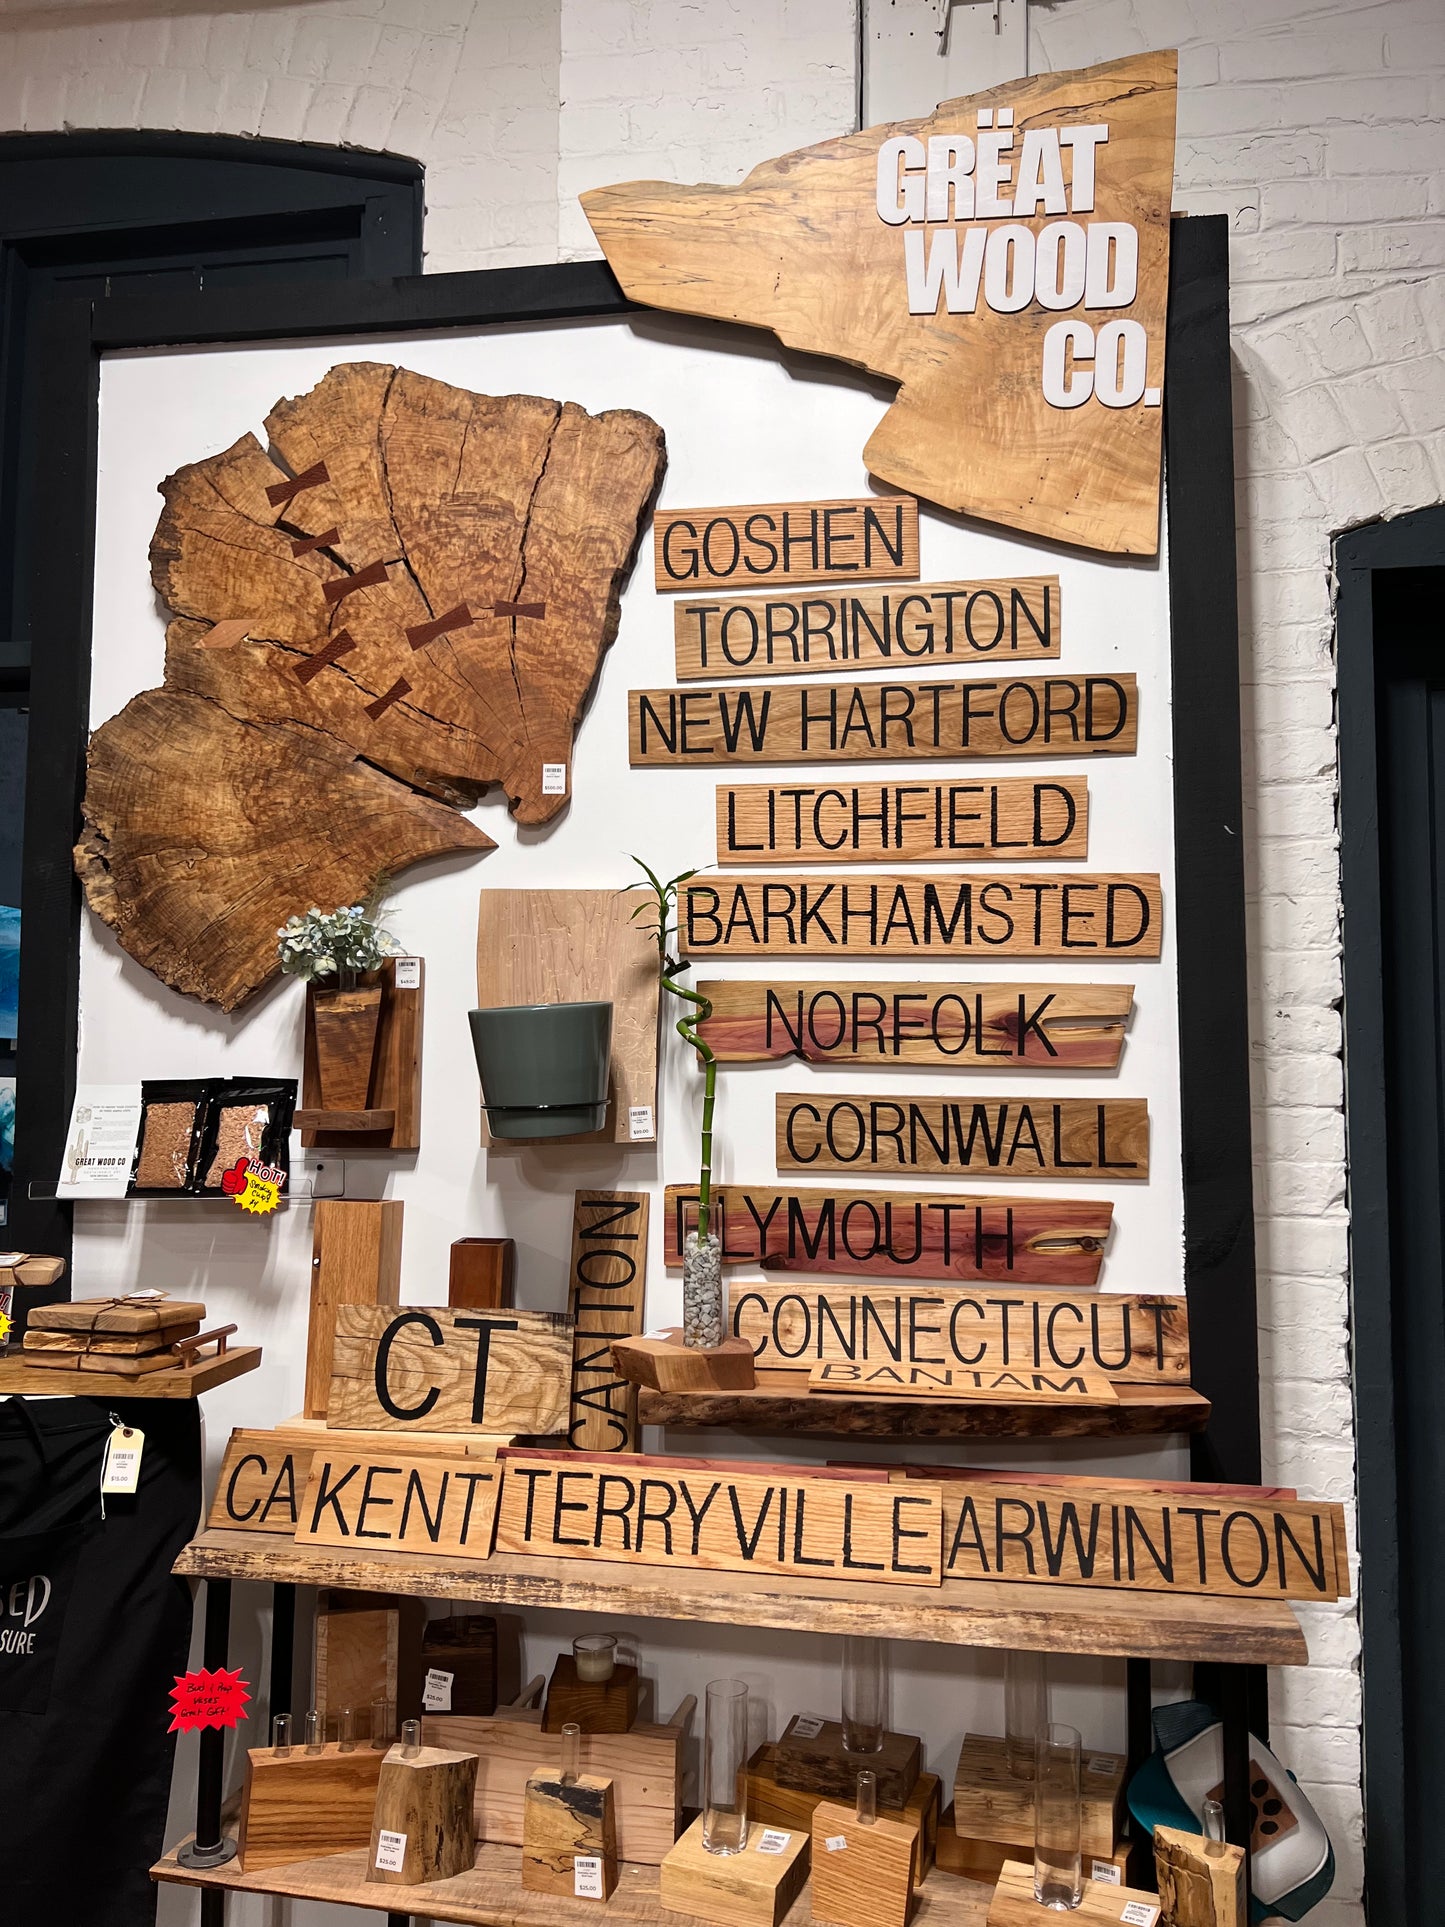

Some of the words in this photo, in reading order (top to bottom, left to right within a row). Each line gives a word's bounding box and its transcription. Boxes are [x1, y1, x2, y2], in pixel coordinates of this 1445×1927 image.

[876, 107, 1109, 226] GRËAT
[903, 220, 1139, 316] WOOD
[1042, 318, 1162, 409] CO.
[662, 505, 904, 580] GOSHEN
[685, 586, 1051, 668] TORRINGTON
[640, 690, 771, 754] NEW
[800, 677, 1128, 751] HARTFORD
[727, 783, 1076, 852] LITCHFIELD
[686, 883, 1150, 949] BARKHAMSTED
[765, 989, 1058, 1057] NORFOLK
[75, 1157, 96, 1166] GREAT
[97, 1157, 117, 1166] WOOD
[117, 1157, 126, 1166] CO
[249, 1159, 285, 1186] HOT!
[786, 1101, 1138, 1170] CORNWALL
[567, 1200, 641, 1453] CANTON
[733, 1292, 1178, 1371] CONNECTICUT
[375, 1312, 518, 1425] CT
[820, 1363, 1090, 1394] BANTAM
[226, 1453, 298, 1523] CA
[309, 1462, 494, 1545] KENT
[513, 1467, 932, 1574] TERRYVILLE
[947, 1496, 1327, 1592] ARWINTON
[0, 1574, 51, 1628] ED
[379, 1857, 397, 1866] $25.00
